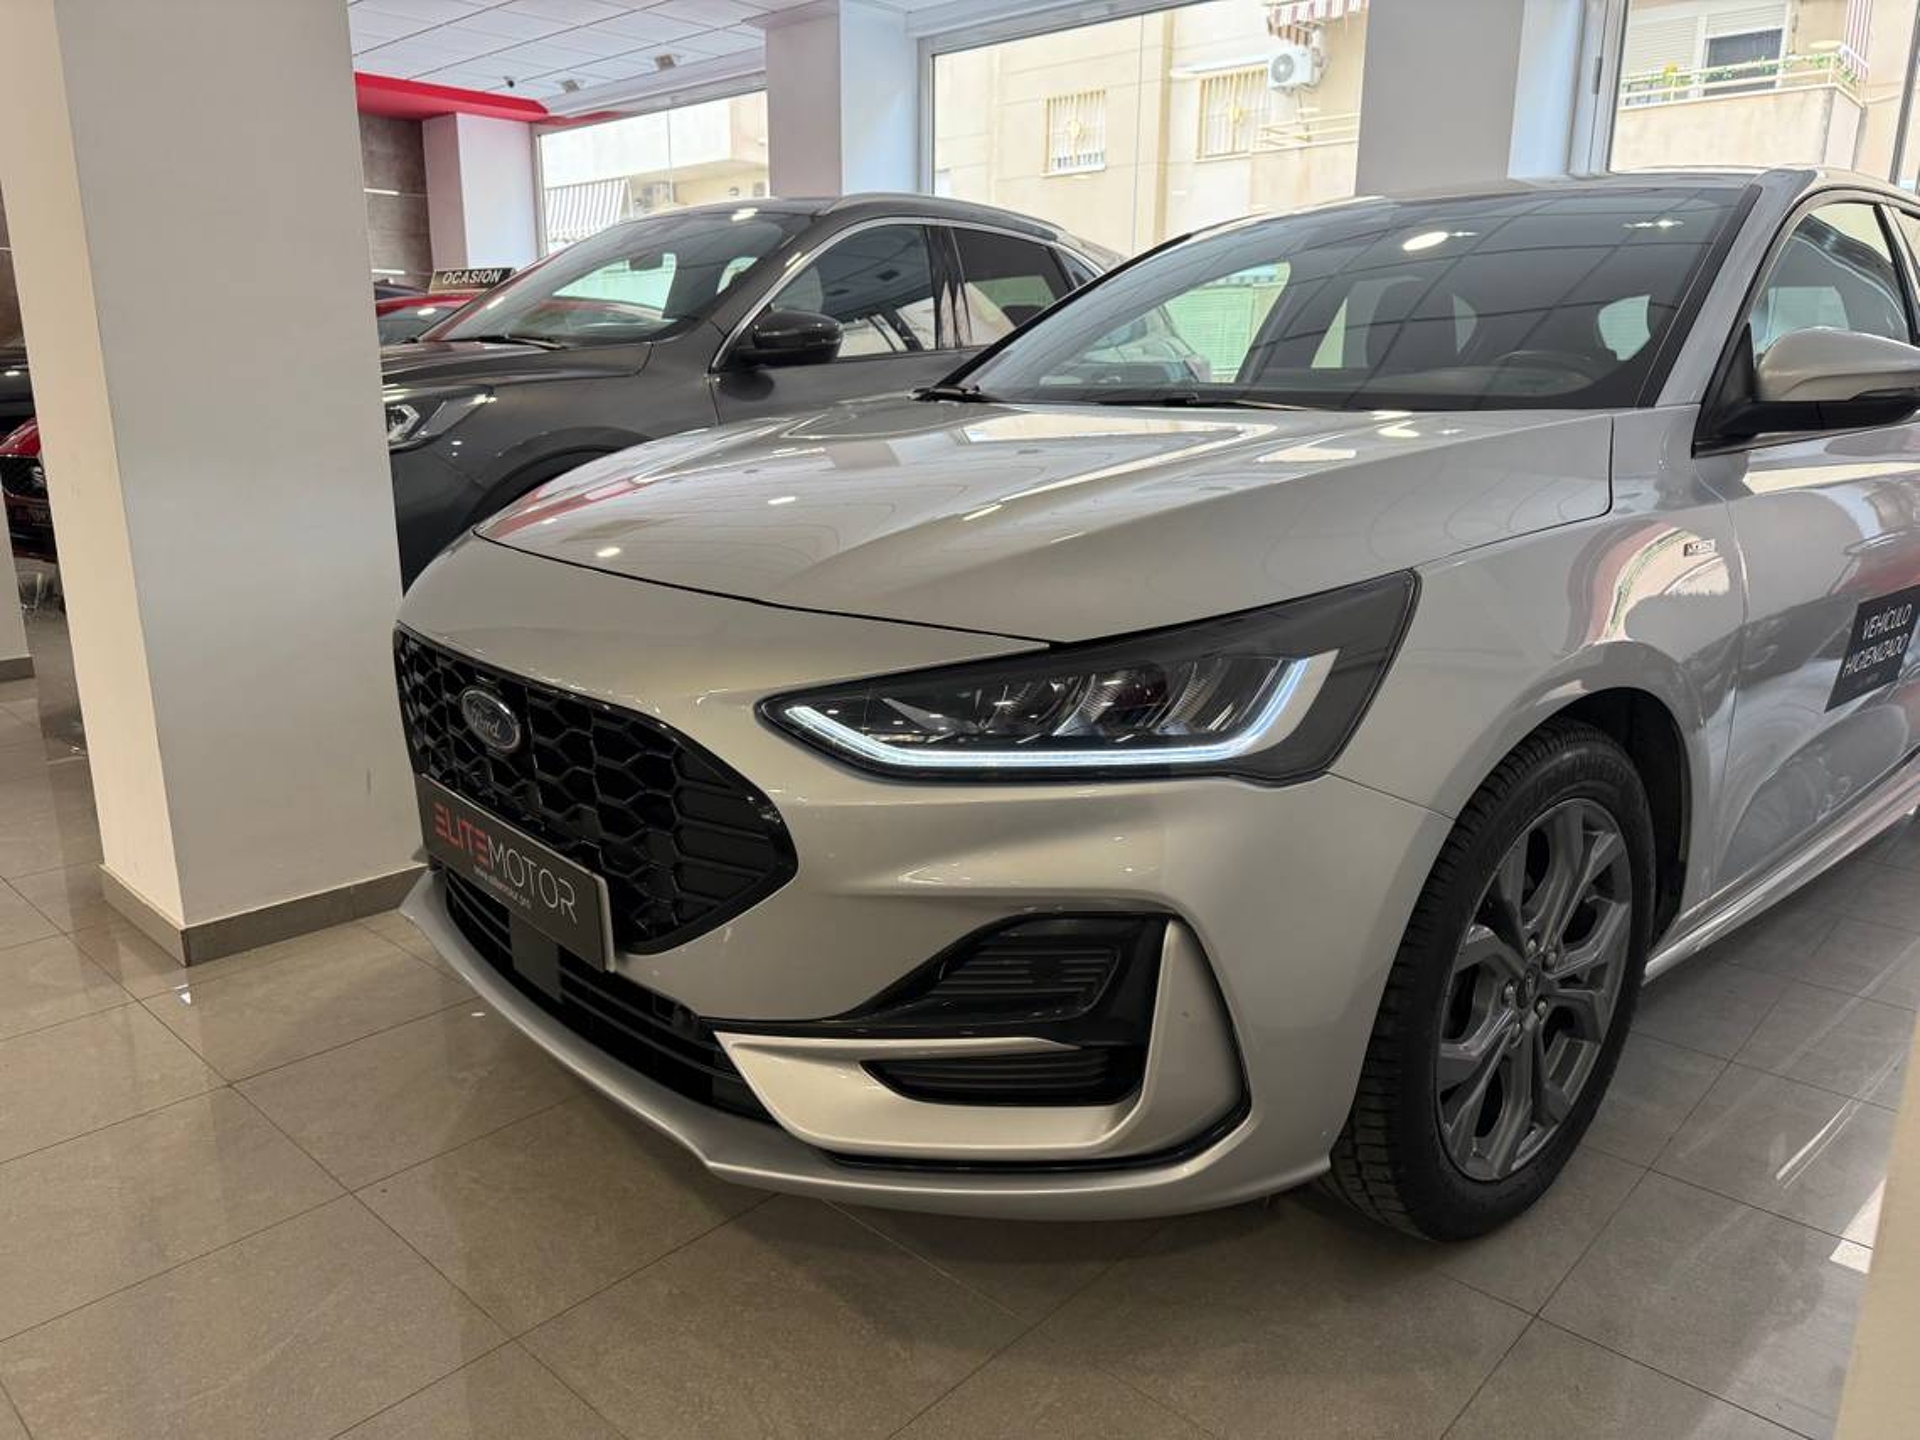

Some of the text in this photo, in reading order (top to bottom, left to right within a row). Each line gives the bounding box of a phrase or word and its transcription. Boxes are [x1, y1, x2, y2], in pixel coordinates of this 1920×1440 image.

[442, 269, 502, 285] OCASION
[471, 700, 502, 741] Ford
[433, 802, 578, 924] ELITEMOTOR
